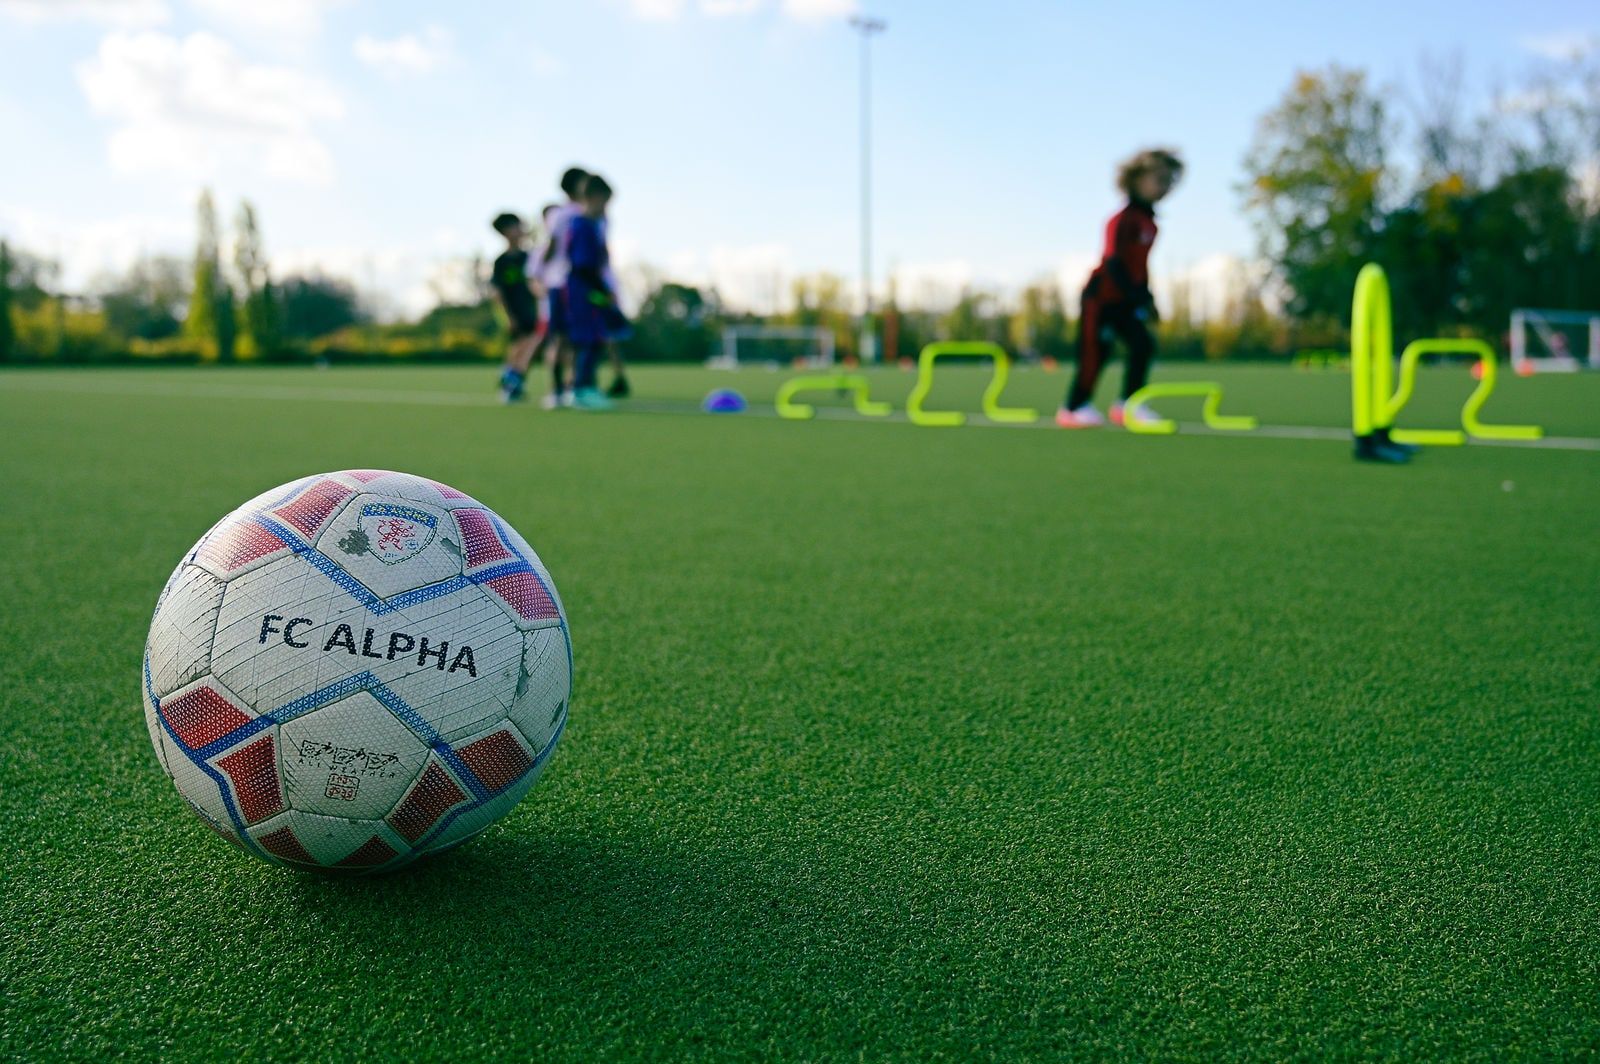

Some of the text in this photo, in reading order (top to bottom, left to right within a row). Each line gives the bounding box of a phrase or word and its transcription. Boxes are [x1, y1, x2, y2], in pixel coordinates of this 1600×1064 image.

[258, 614, 477, 678] FC ALPHA
[329, 765, 396, 778] WEATHER
